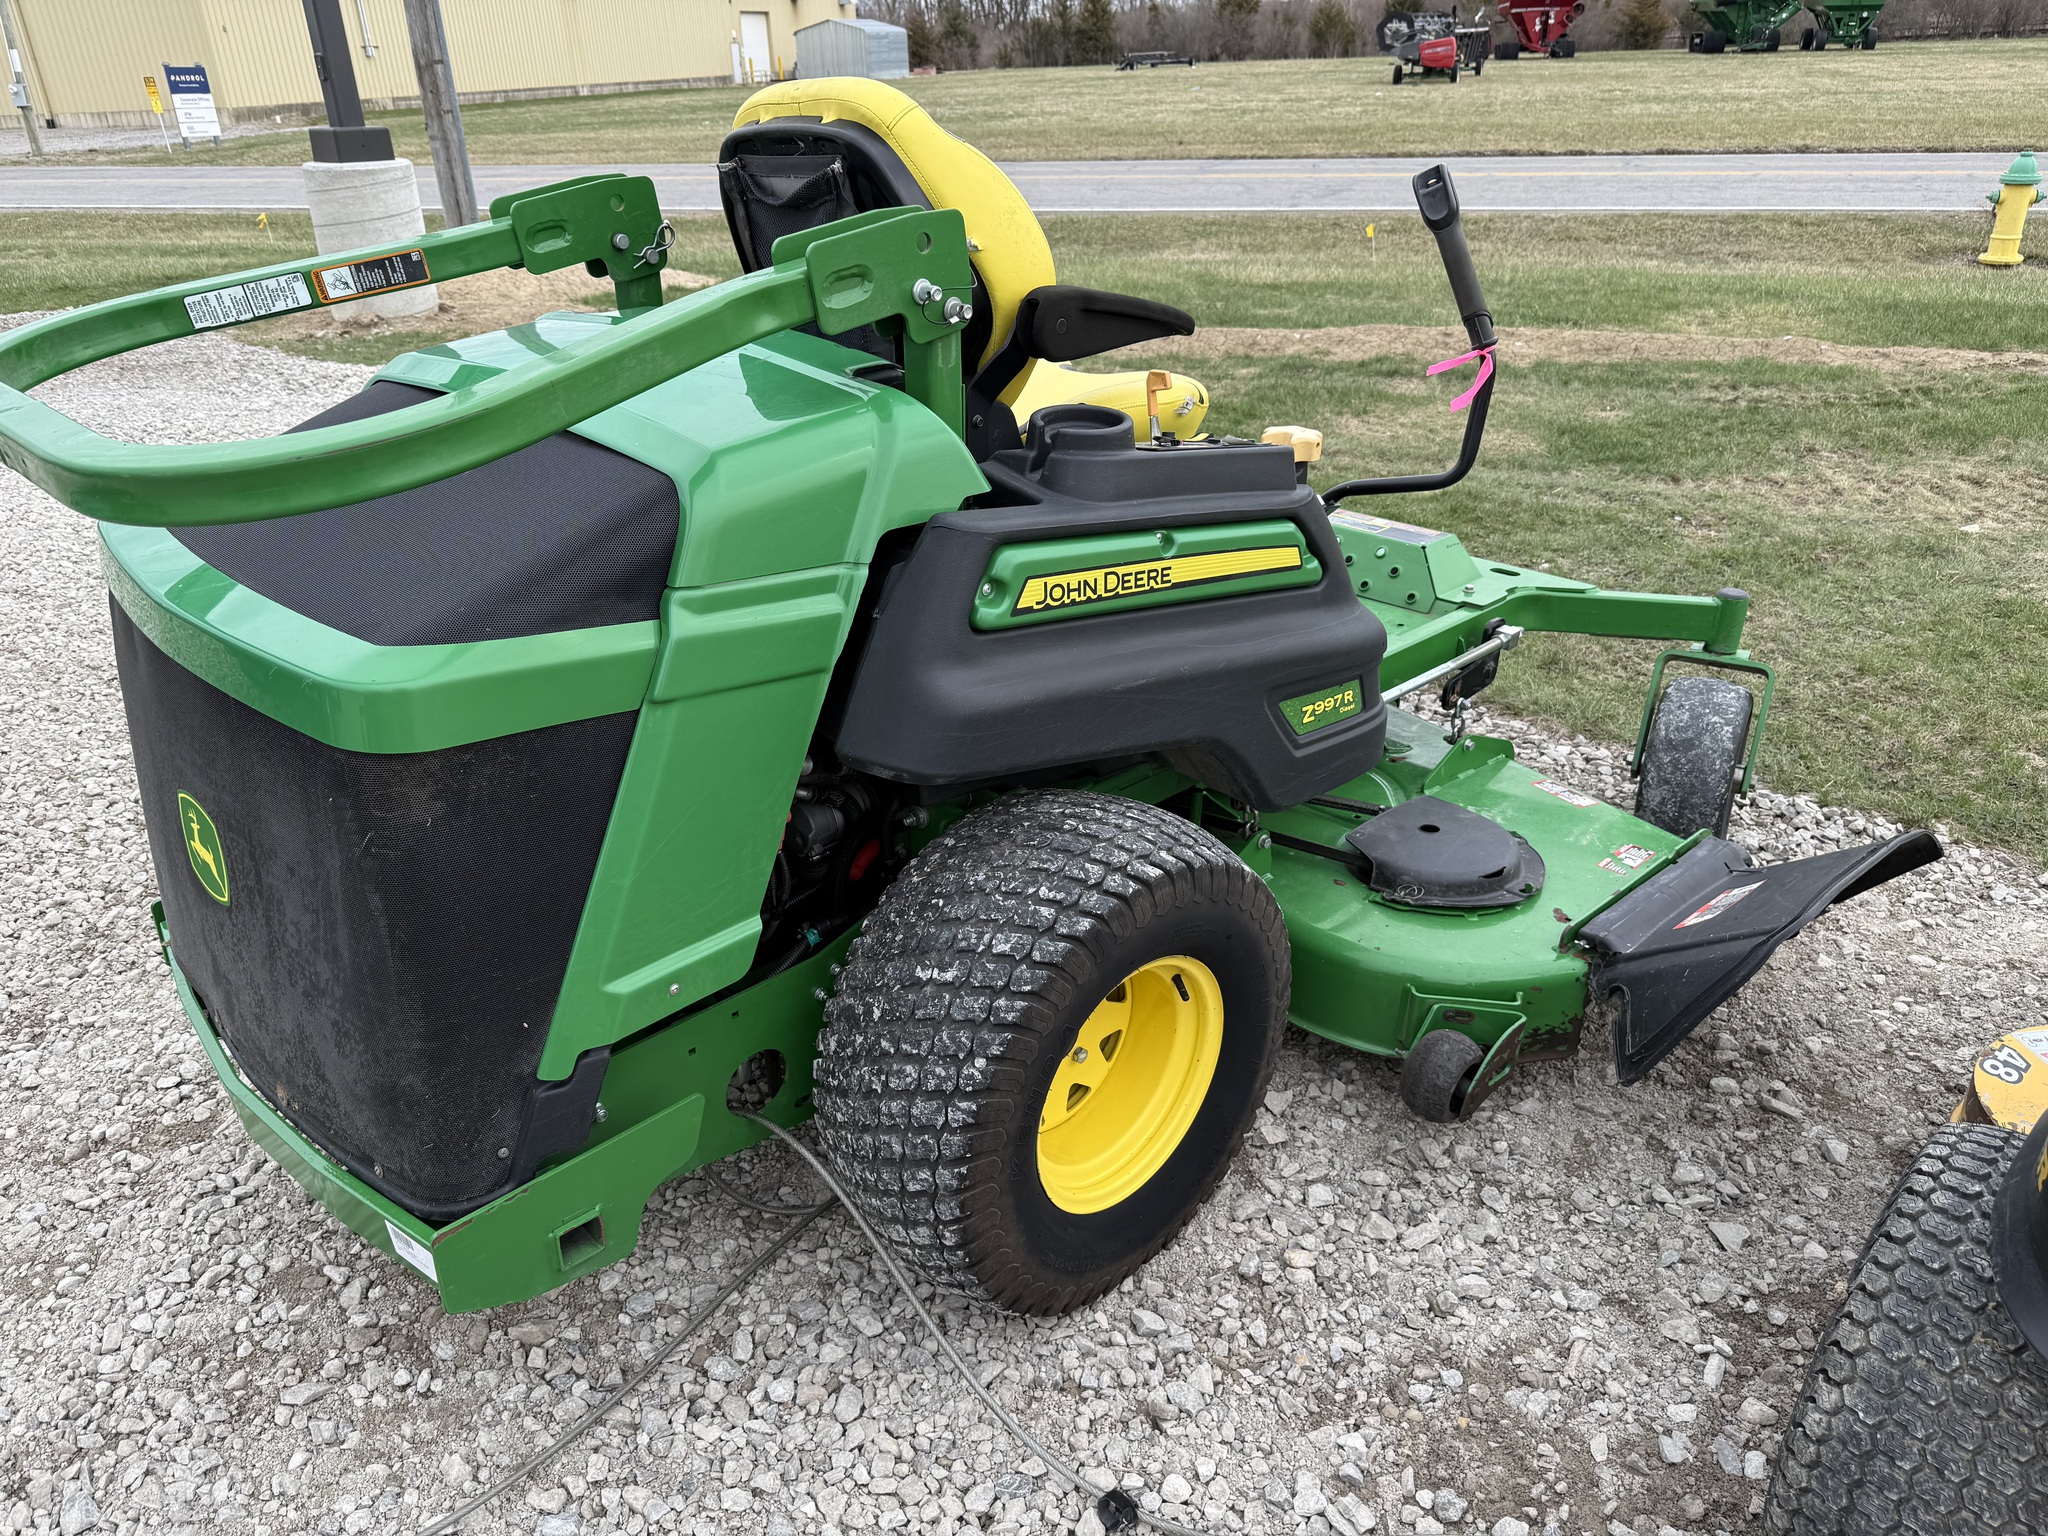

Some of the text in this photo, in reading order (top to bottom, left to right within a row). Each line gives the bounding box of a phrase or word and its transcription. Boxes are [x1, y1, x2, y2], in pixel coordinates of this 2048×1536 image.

[170, 74, 205, 82] PANDROL
[1036, 566, 1172, 605] JOHN DEERE
[1302, 690, 1353, 724] Z997R
[1339, 703, 1356, 713] Diesel
[1982, 1046, 2028, 1082] 48
